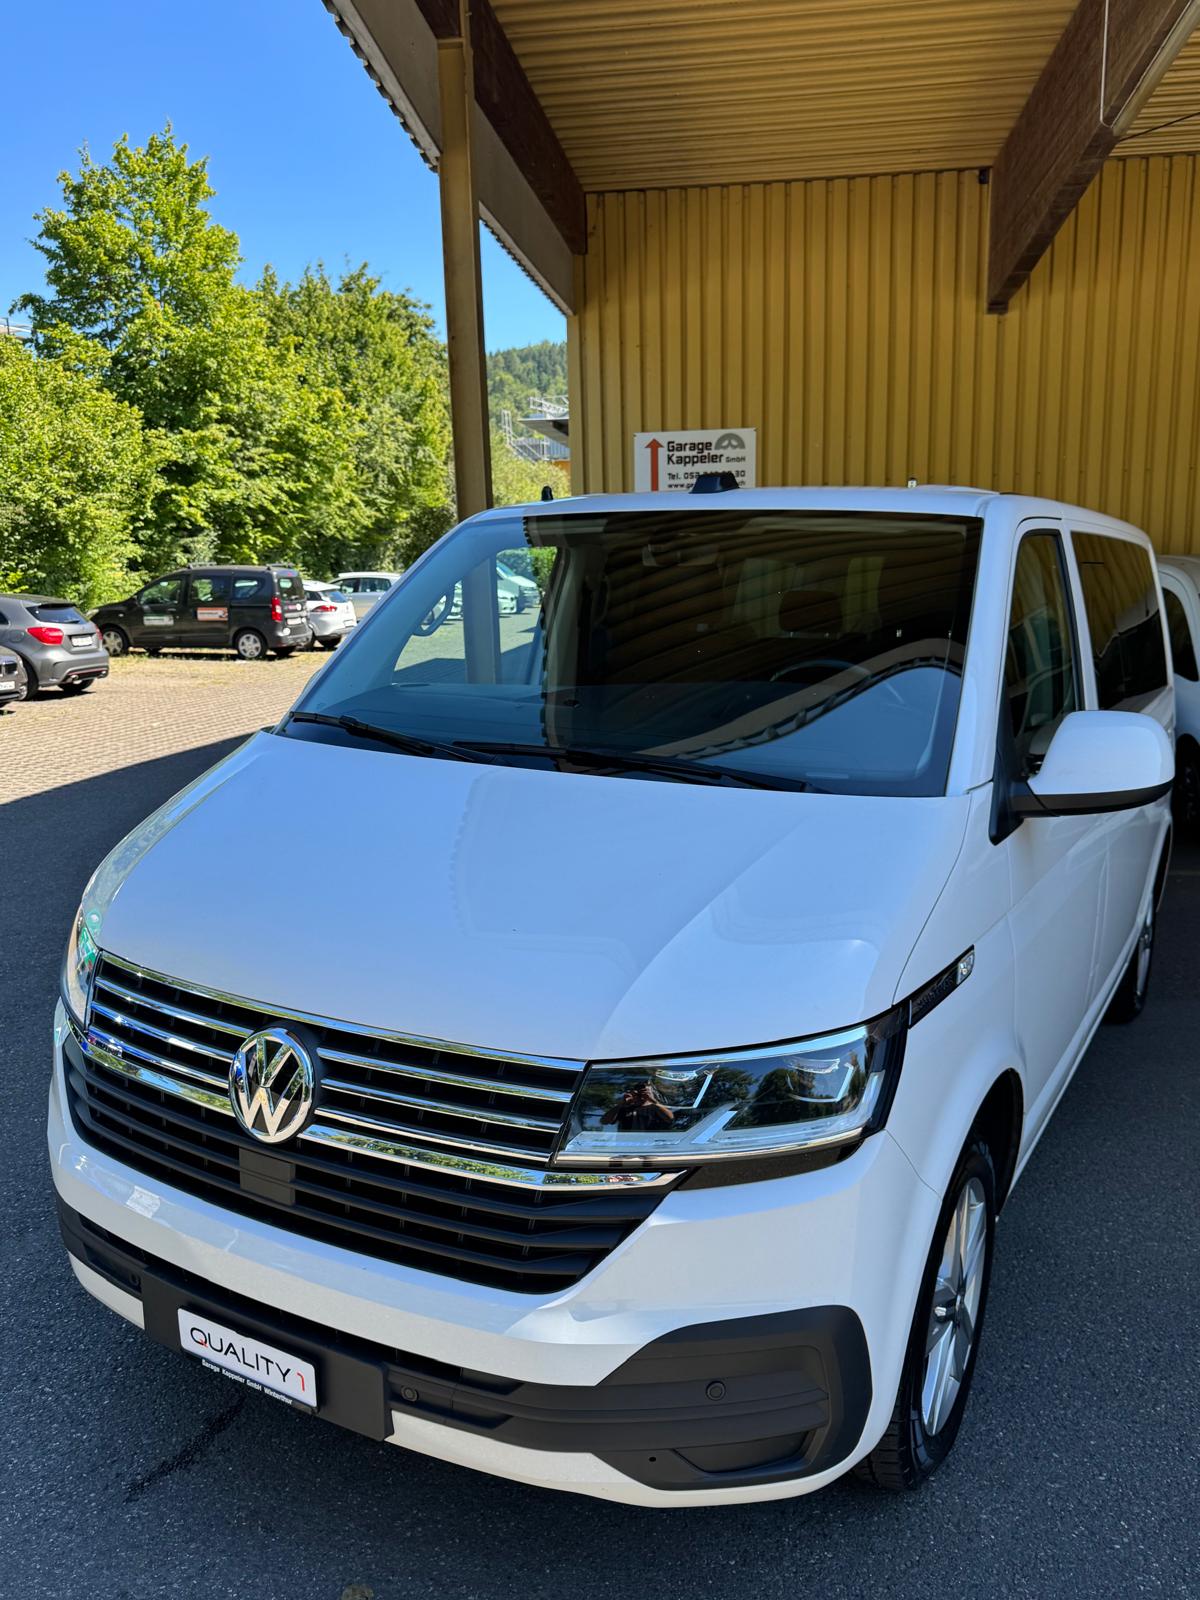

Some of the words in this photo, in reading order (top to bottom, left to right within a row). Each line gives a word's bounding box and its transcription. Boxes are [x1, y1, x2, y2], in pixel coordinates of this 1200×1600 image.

[666, 441, 713, 454] Garage
[666, 453, 724, 467] Kappeler
[667, 472, 681, 480] Tel.
[229, 1027, 314, 1144] VW
